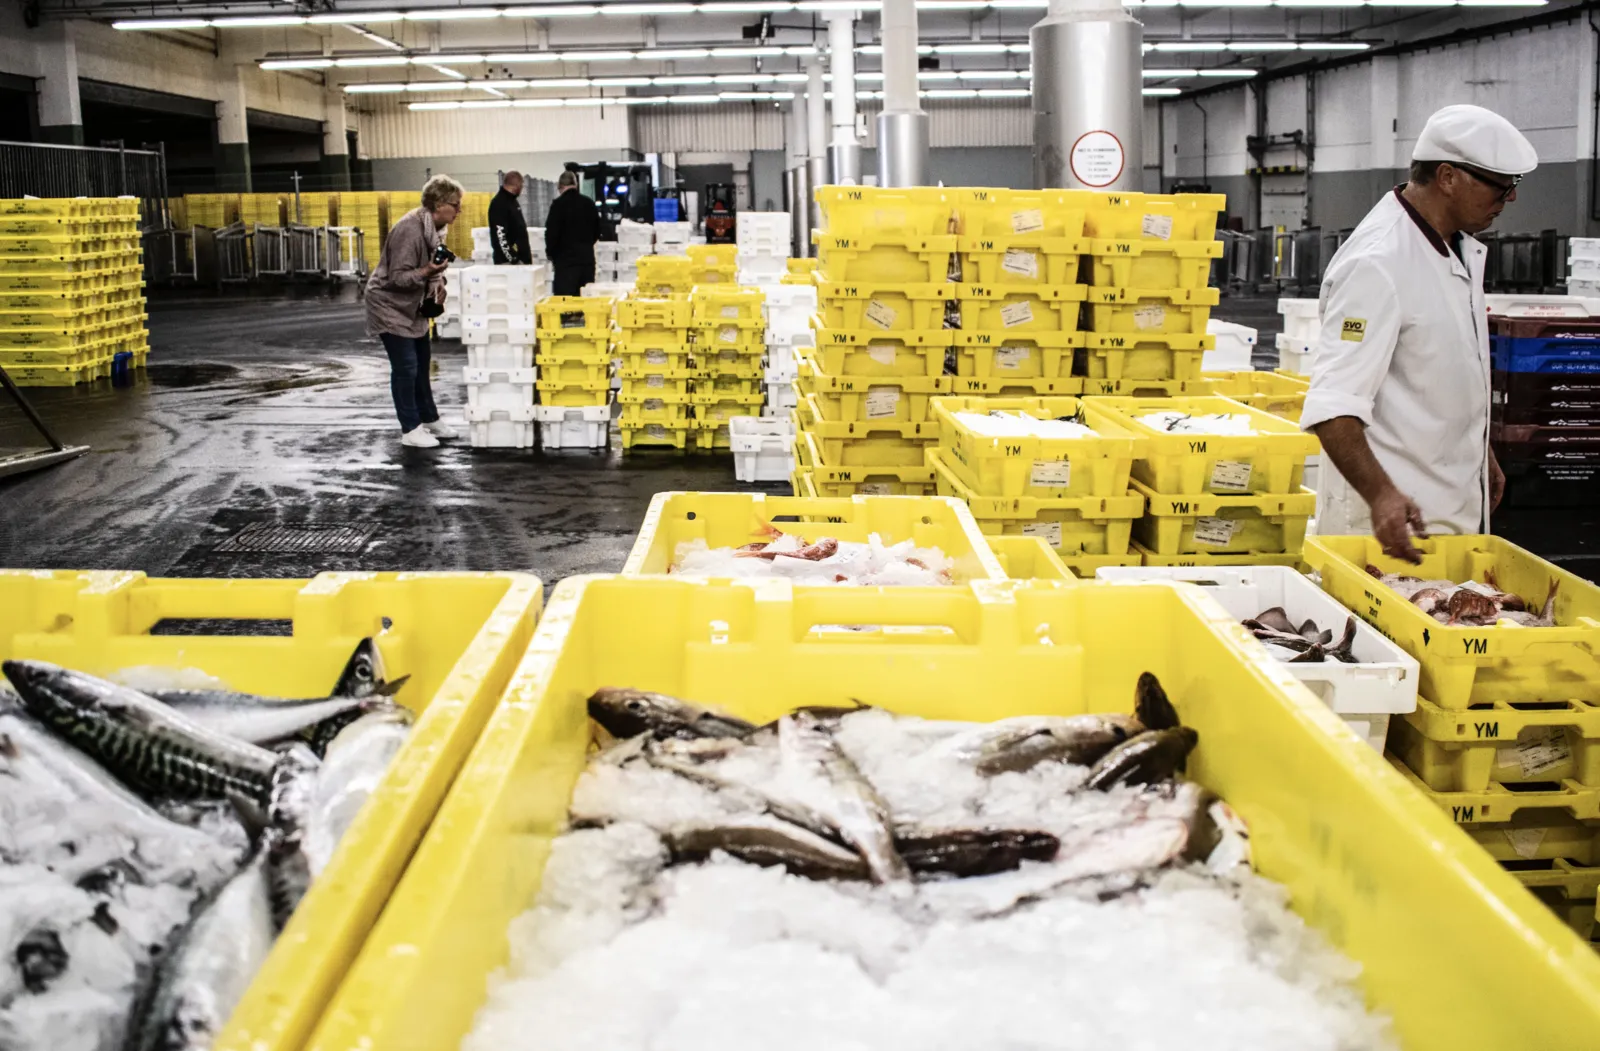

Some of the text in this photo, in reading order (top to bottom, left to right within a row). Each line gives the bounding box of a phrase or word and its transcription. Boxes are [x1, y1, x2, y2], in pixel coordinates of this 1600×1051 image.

[848, 192, 861, 200] YM
[974, 192, 987, 200] YM
[1108, 197, 1120, 205] YM
[836, 239, 849, 248] YM
[981, 241, 993, 250] YM
[1116, 244, 1130, 253] YM
[845, 288, 857, 296] YM
[972, 288, 984, 296] YM
[1103, 293, 1115, 302] YM
[1344, 321, 1362, 330] SVO
[833, 334, 846, 343] YM
[977, 335, 990, 344] YM
[1110, 338, 1124, 347] YM
[841, 382, 853, 391] YM
[968, 381, 979, 390] YM
[1101, 385, 1113, 394] YM
[1005, 446, 1021, 456] YM
[1189, 441, 1206, 453] YM
[838, 472, 851, 481] YM
[1171, 502, 1189, 513] YM
[1463, 639, 1487, 654] YM
[1475, 722, 1498, 737] YM
[1453, 806, 1473, 821] YM
